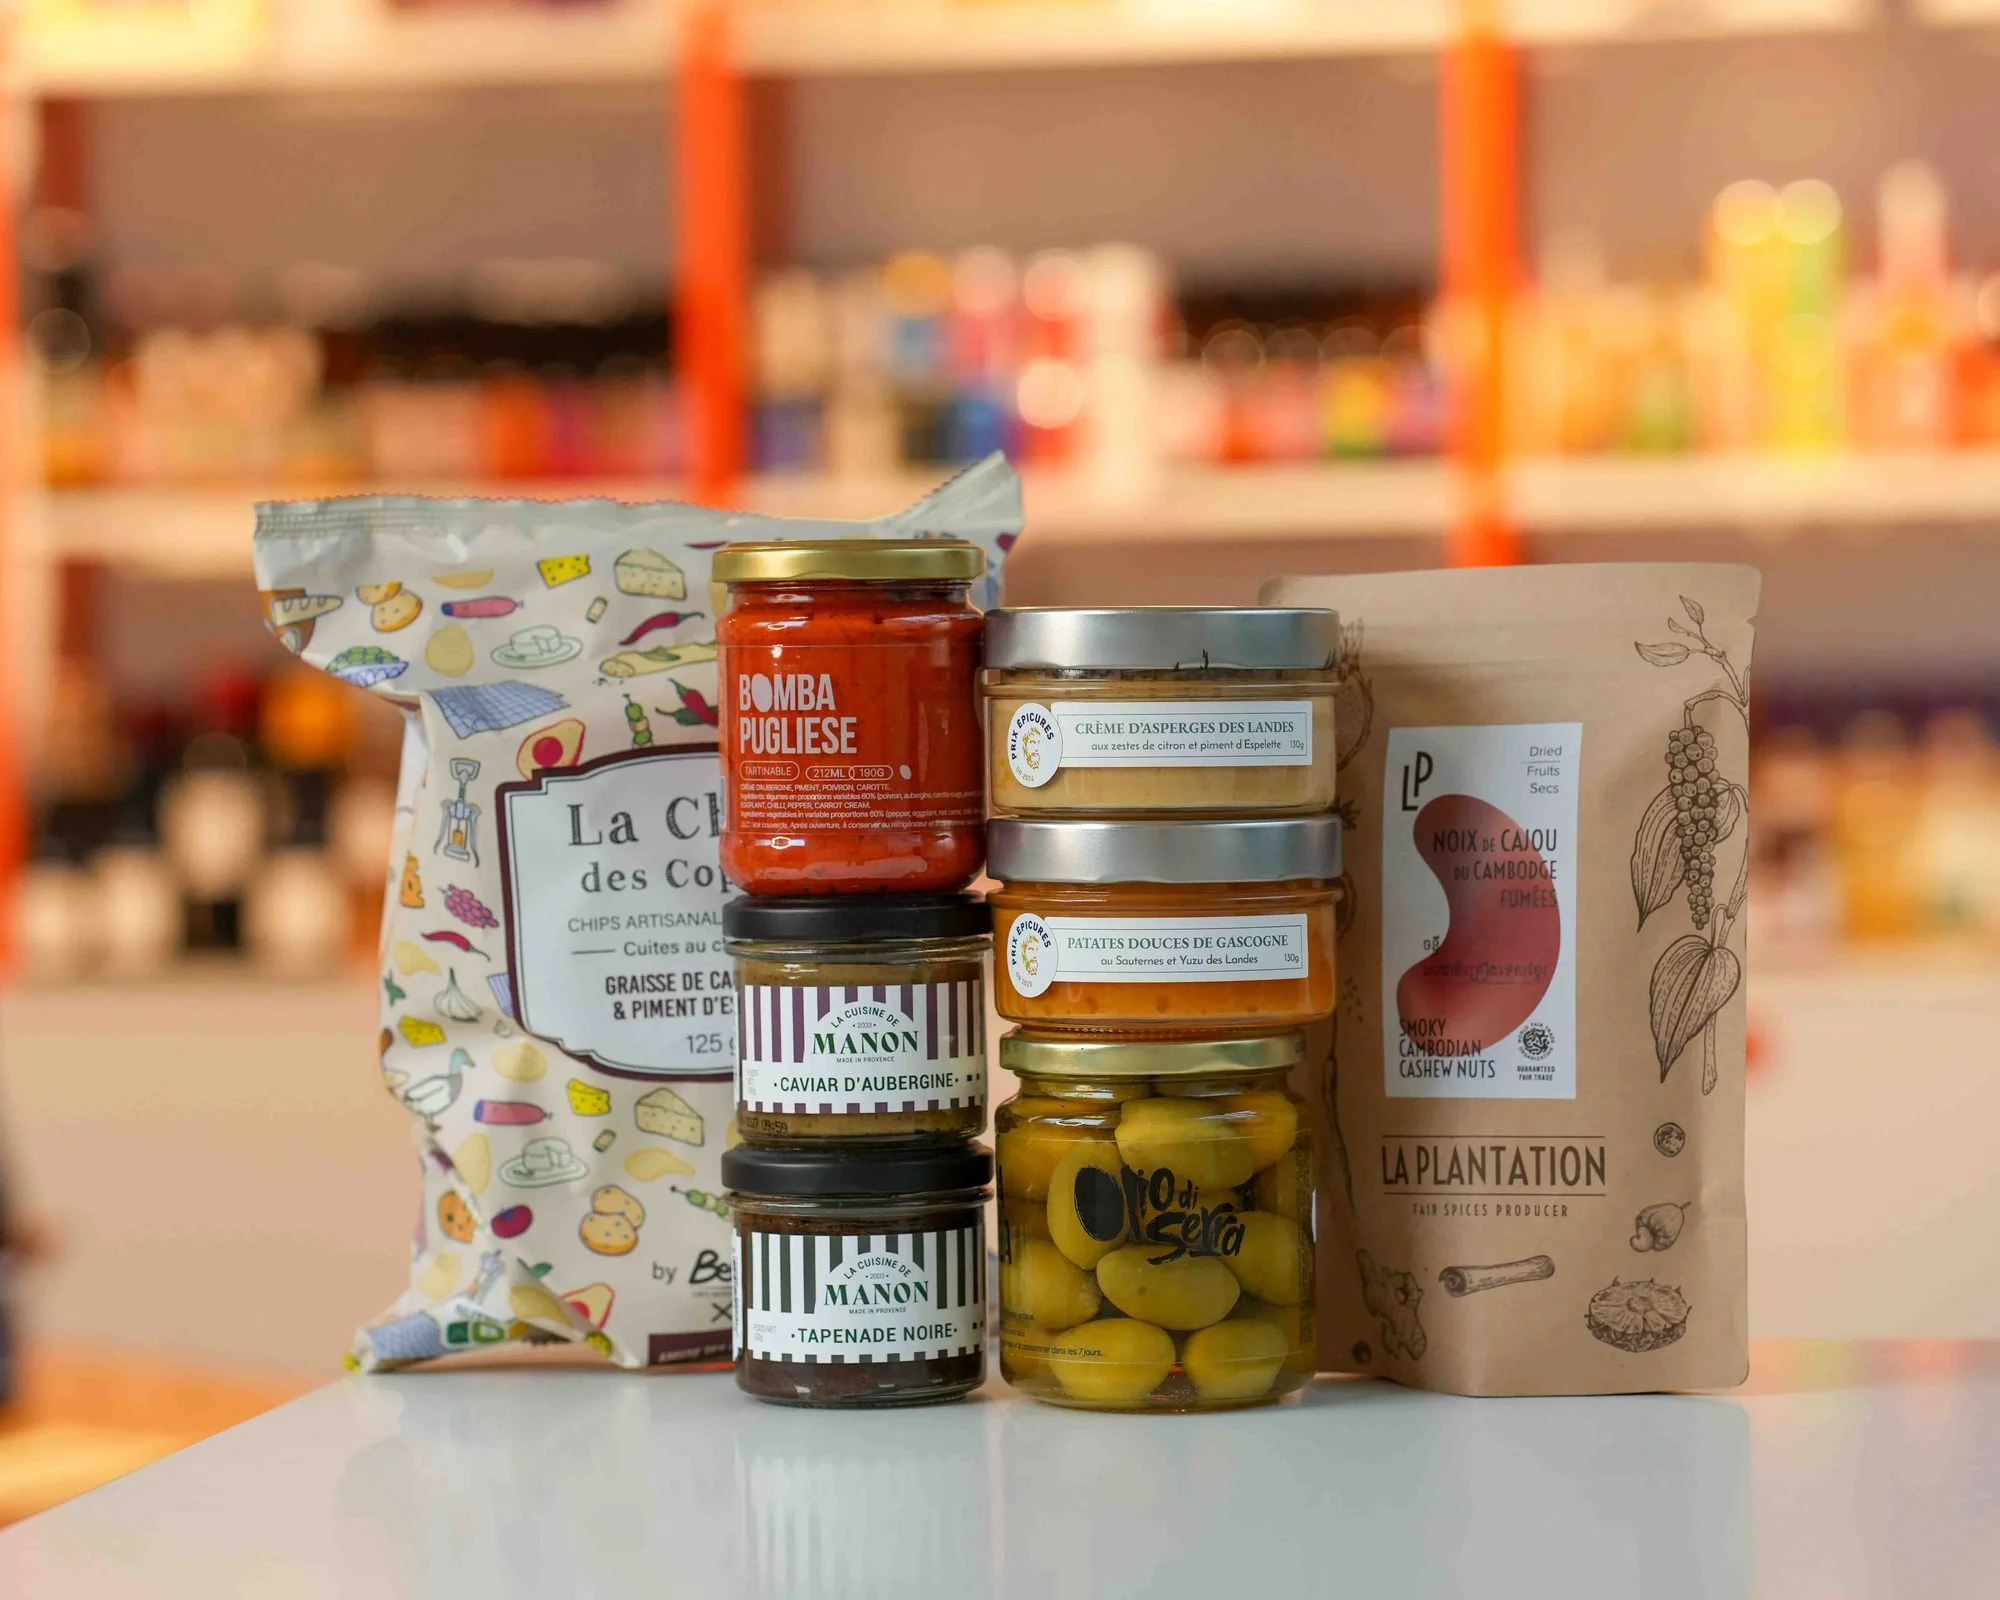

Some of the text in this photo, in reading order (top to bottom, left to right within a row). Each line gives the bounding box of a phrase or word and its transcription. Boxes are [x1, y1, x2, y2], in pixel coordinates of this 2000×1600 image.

[739, 673, 836, 712] BOMBA
[740, 716, 858, 755] PUGLIESE
[1075, 720, 1294, 735] CRÈME D'ASPERGES DES LANDES
[1010, 730, 1018, 760] PRIX
[1091, 739, 1282, 753] aux zestes de citron et piment d'Espelette
[1290, 740, 1304, 752] 130g
[1529, 746, 1562, 758] Dried
[744, 766, 792, 777] TARTINABLE
[813, 768, 846, 778] 212ML
[860, 768, 885, 778] 190G
[1402, 751, 1434, 811] LP
[1527, 765, 1560, 778] Fruits
[794, 784, 821, 792] PIMENT,
[822, 784, 855, 792] POIVRON,
[1530, 783, 1559, 794] Secs
[566, 802, 640, 847] La
[1433, 830, 1478, 852] NOIX
[1500, 829, 1558, 852] CAJOU
[580, 860, 648, 894] des
[1473, 860, 1558, 880] CAMBODGE
[1500, 886, 1557, 908] FUMÉES
[568, 916, 620, 933] CHIPS
[623, 940, 680, 957] Cuites
[685, 942, 706, 954] au
[1067, 934, 1288, 950] PATATES DOUCES DE GASCOGNE
[1100, 954, 1258, 966] au Sauternes et Yuzu des Landes
[1284, 954, 1300, 965] 130g
[605, 974, 676, 995] GRAISSE
[682, 972, 704, 992] DE
[613, 1002, 627, 1020] &
[632, 997, 698, 1019] PIMENT
[830, 1006, 900, 1029] LA CUISINE DE
[1399, 1018, 1446, 1037] SMOKY
[686, 1033, 722, 1054] 125
[812, 1030, 920, 1054] MANON
[1399, 1040, 1482, 1058] CAMBODIAN
[836, 1056, 854, 1064] MADE
[1400, 1060, 1496, 1078] CASHEW NUTS
[780, 1076, 838, 1092] CAVIAR
[844, 1072, 954, 1092] D'AUBERGINE
[1381, 1145, 1606, 1186] LA PLANTATION
[1178, 1180, 1200, 1210] di
[1412, 1204, 1568, 1217] FAIR SPICES PRODUCER
[1146, 1202, 1247, 1265] Serra
[652, 1261, 678, 1285] by
[843, 1257, 912, 1280] LA CUISINE DE
[870, 1272, 884, 1280] 2003
[824, 1280, 929, 1306] MANON
[876, 1306, 907, 1314] PROVENCE
[798, 1323, 953, 1344] TAPENADE NOIRE
[1051, 1346, 1066, 1354] dans
[1068, 1347, 1078, 1355] les
[1084, 1348, 1102, 1357] jours.
